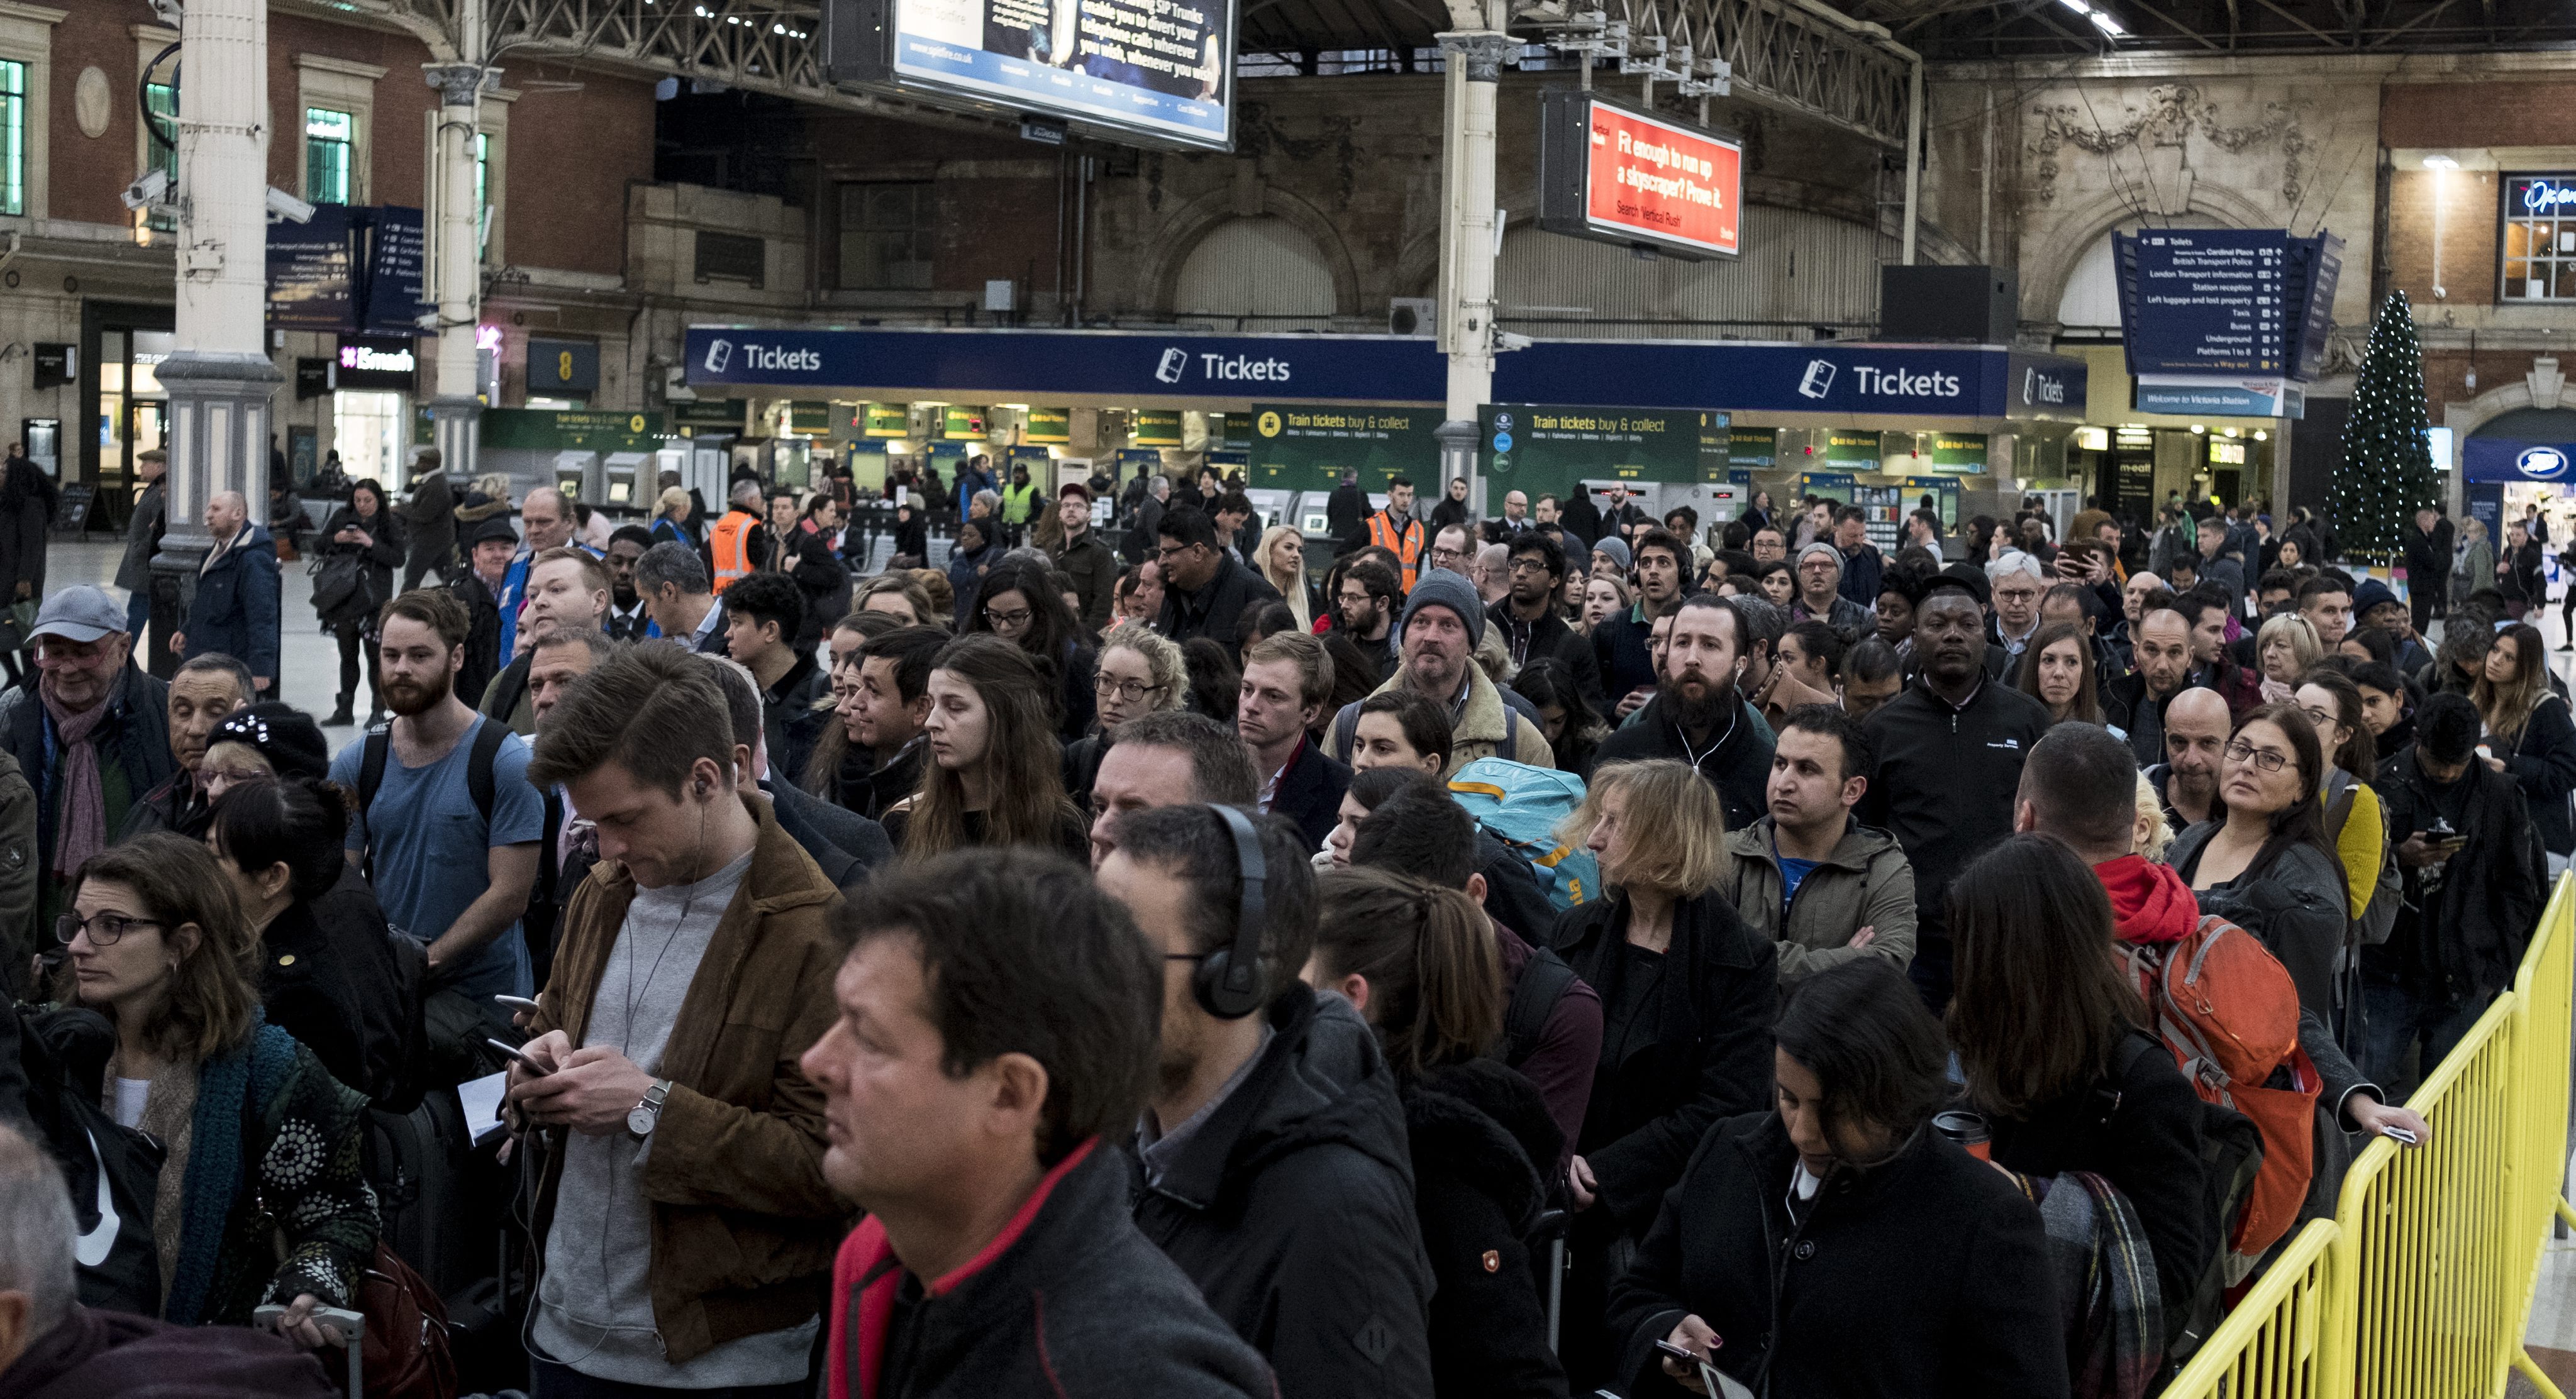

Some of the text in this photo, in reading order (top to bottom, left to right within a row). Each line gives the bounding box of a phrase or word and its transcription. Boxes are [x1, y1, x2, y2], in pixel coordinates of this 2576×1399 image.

[1082, 0, 1116, 19] enable
[1116, 9, 1135, 25] you
[1136, 13, 1146, 28] to
[1147, 15, 1175, 36] divert
[1175, 26, 1198, 41] your
[1156, 0, 1171, 14] SIP
[1172, 3, 1204, 24] Trunks
[1080, 17, 1197, 60] telephone calls wherever
[1080, 38, 1100, 55] you
[1100, 42, 1126, 64] wish,
[1126, 49, 1174, 72] whenever
[1174, 63, 1192, 78] you
[1618, 130, 1713, 182] Fit enough to run up
[1617, 166, 1625, 184] a
[1626, 164, 1685, 200] skyscraper?
[1686, 181, 1713, 207] Prove
[1617, 200, 1639, 218] Search
[2170, 238, 2193, 246] Toilets
[2206, 248, 2234, 256] Cardinal
[2235, 248, 2254, 256] Place
[2173, 257, 2253, 266] British Transport Police
[2150, 270, 2177, 278] London
[2177, 270, 2211, 279] Transport
[2192, 283, 2253, 293] Station reception
[2147, 295, 2251, 306] Left luggage and lost property
[2233, 309, 2250, 317] Taxis
[2230, 322, 2251, 331] Buses
[2206, 335, 2252, 345] Underground
[357, 346, 414, 372] iSmash
[743, 344, 821, 372] Tickets
[2197, 347, 2231, 357] Platforms
[1201, 353, 1290, 382] Tickets
[2219, 361, 2235, 370] Way
[1853, 366, 1960, 398] Tickets
[2038, 373, 2063, 404] Tickets
[2147, 394, 2250, 406] Welcome to Victoria Station
[1288, 413, 1409, 430] Train tickets buy & collect
[1533, 415, 1665, 433] Train tickets buy & collect
[1964, 441, 1984, 450] Tickets
